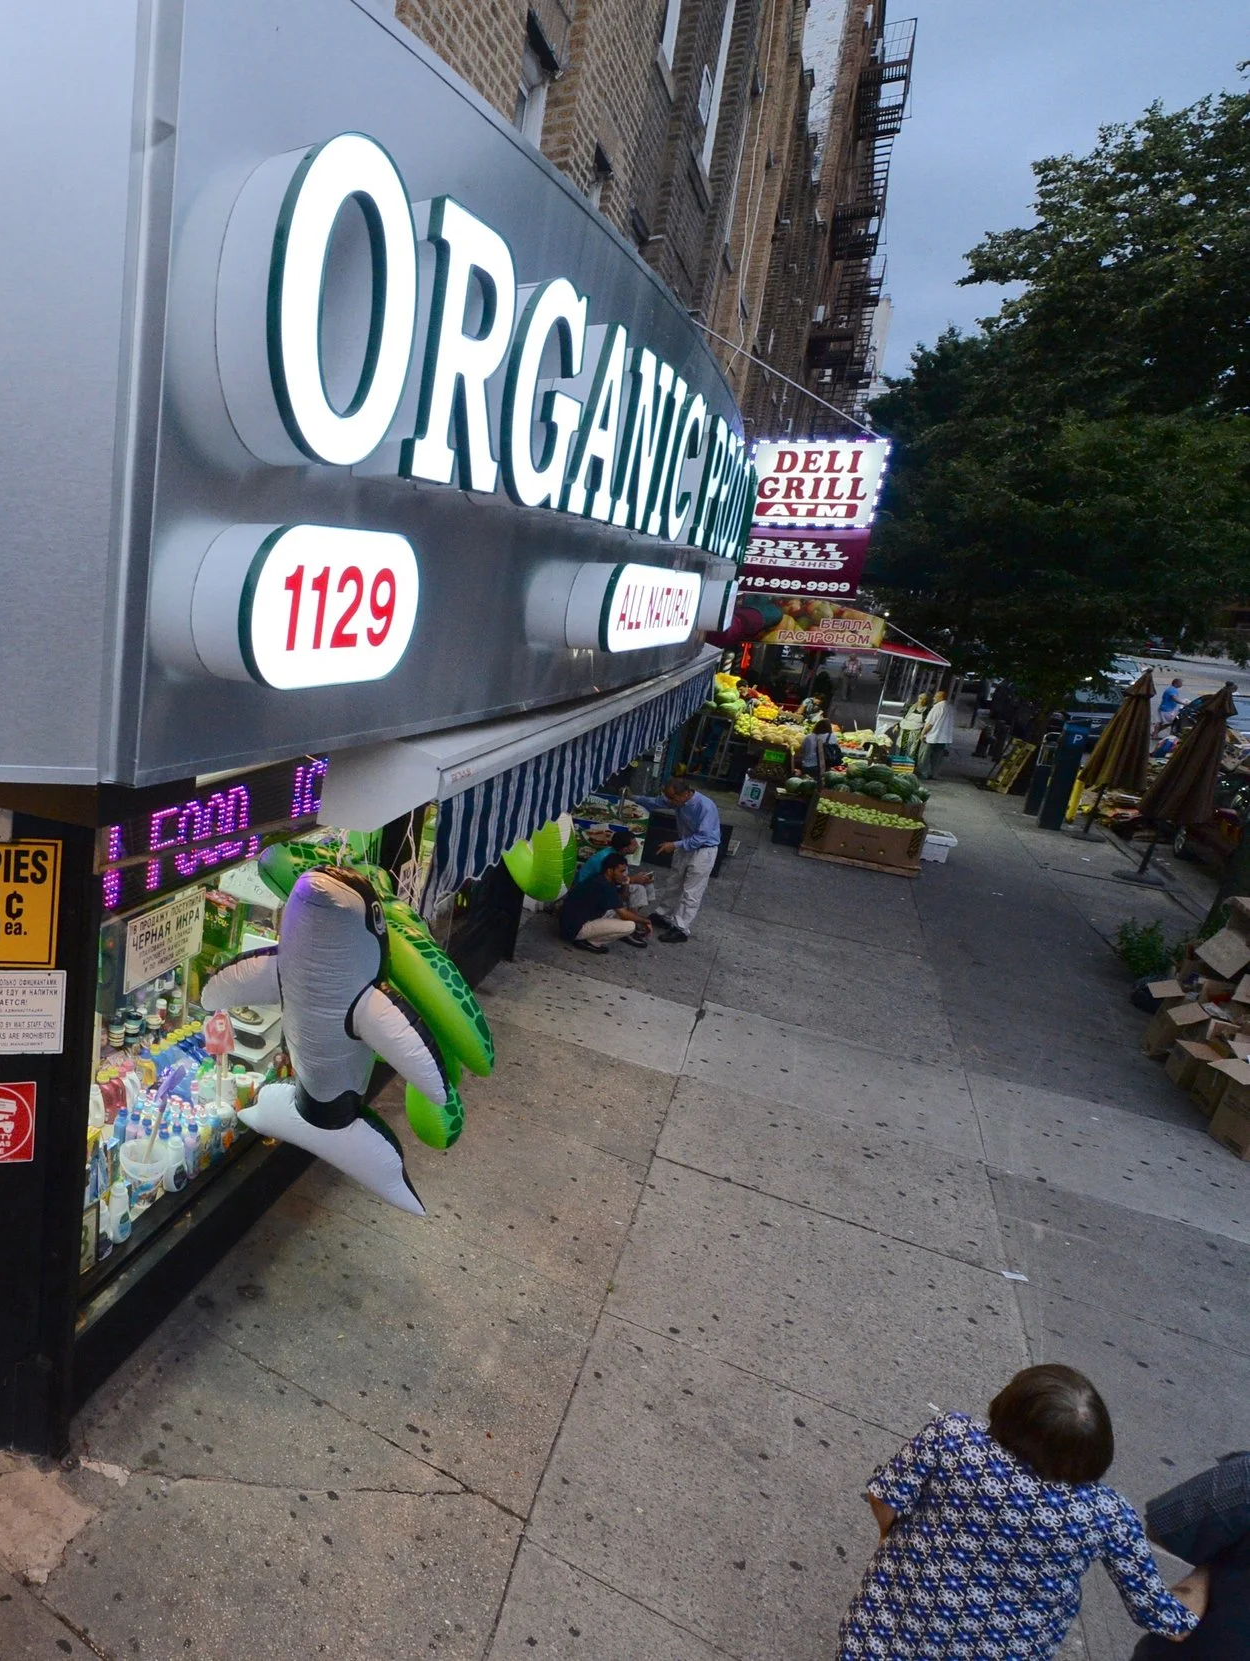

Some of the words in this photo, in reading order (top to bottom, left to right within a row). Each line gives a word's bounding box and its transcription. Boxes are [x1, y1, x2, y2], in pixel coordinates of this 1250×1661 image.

[272, 132, 707, 543] ORGANIC
[773, 450, 863, 473] DELI
[757, 476, 867, 500] GRILL
[764, 503, 848, 517] ATM
[744, 545, 849, 561] GRILL
[750, 538, 839, 552] DELI
[790, 560, 837, 569] 24HRS
[737, 576, 850, 592] 718-999-9999
[282, 565, 398, 651] 1129
[616, 584, 644, 631] ALL
[644, 586, 693, 629] NATURAL
[820, 618, 873, 631] БЕЛЛА
[778, 630, 870, 645] ГАСТРОНОМ
[4, 921, 28, 936] ea.
[132, 920, 171, 951] ЧЕРНАЯ
[176, 907, 199, 931] ИКРА
